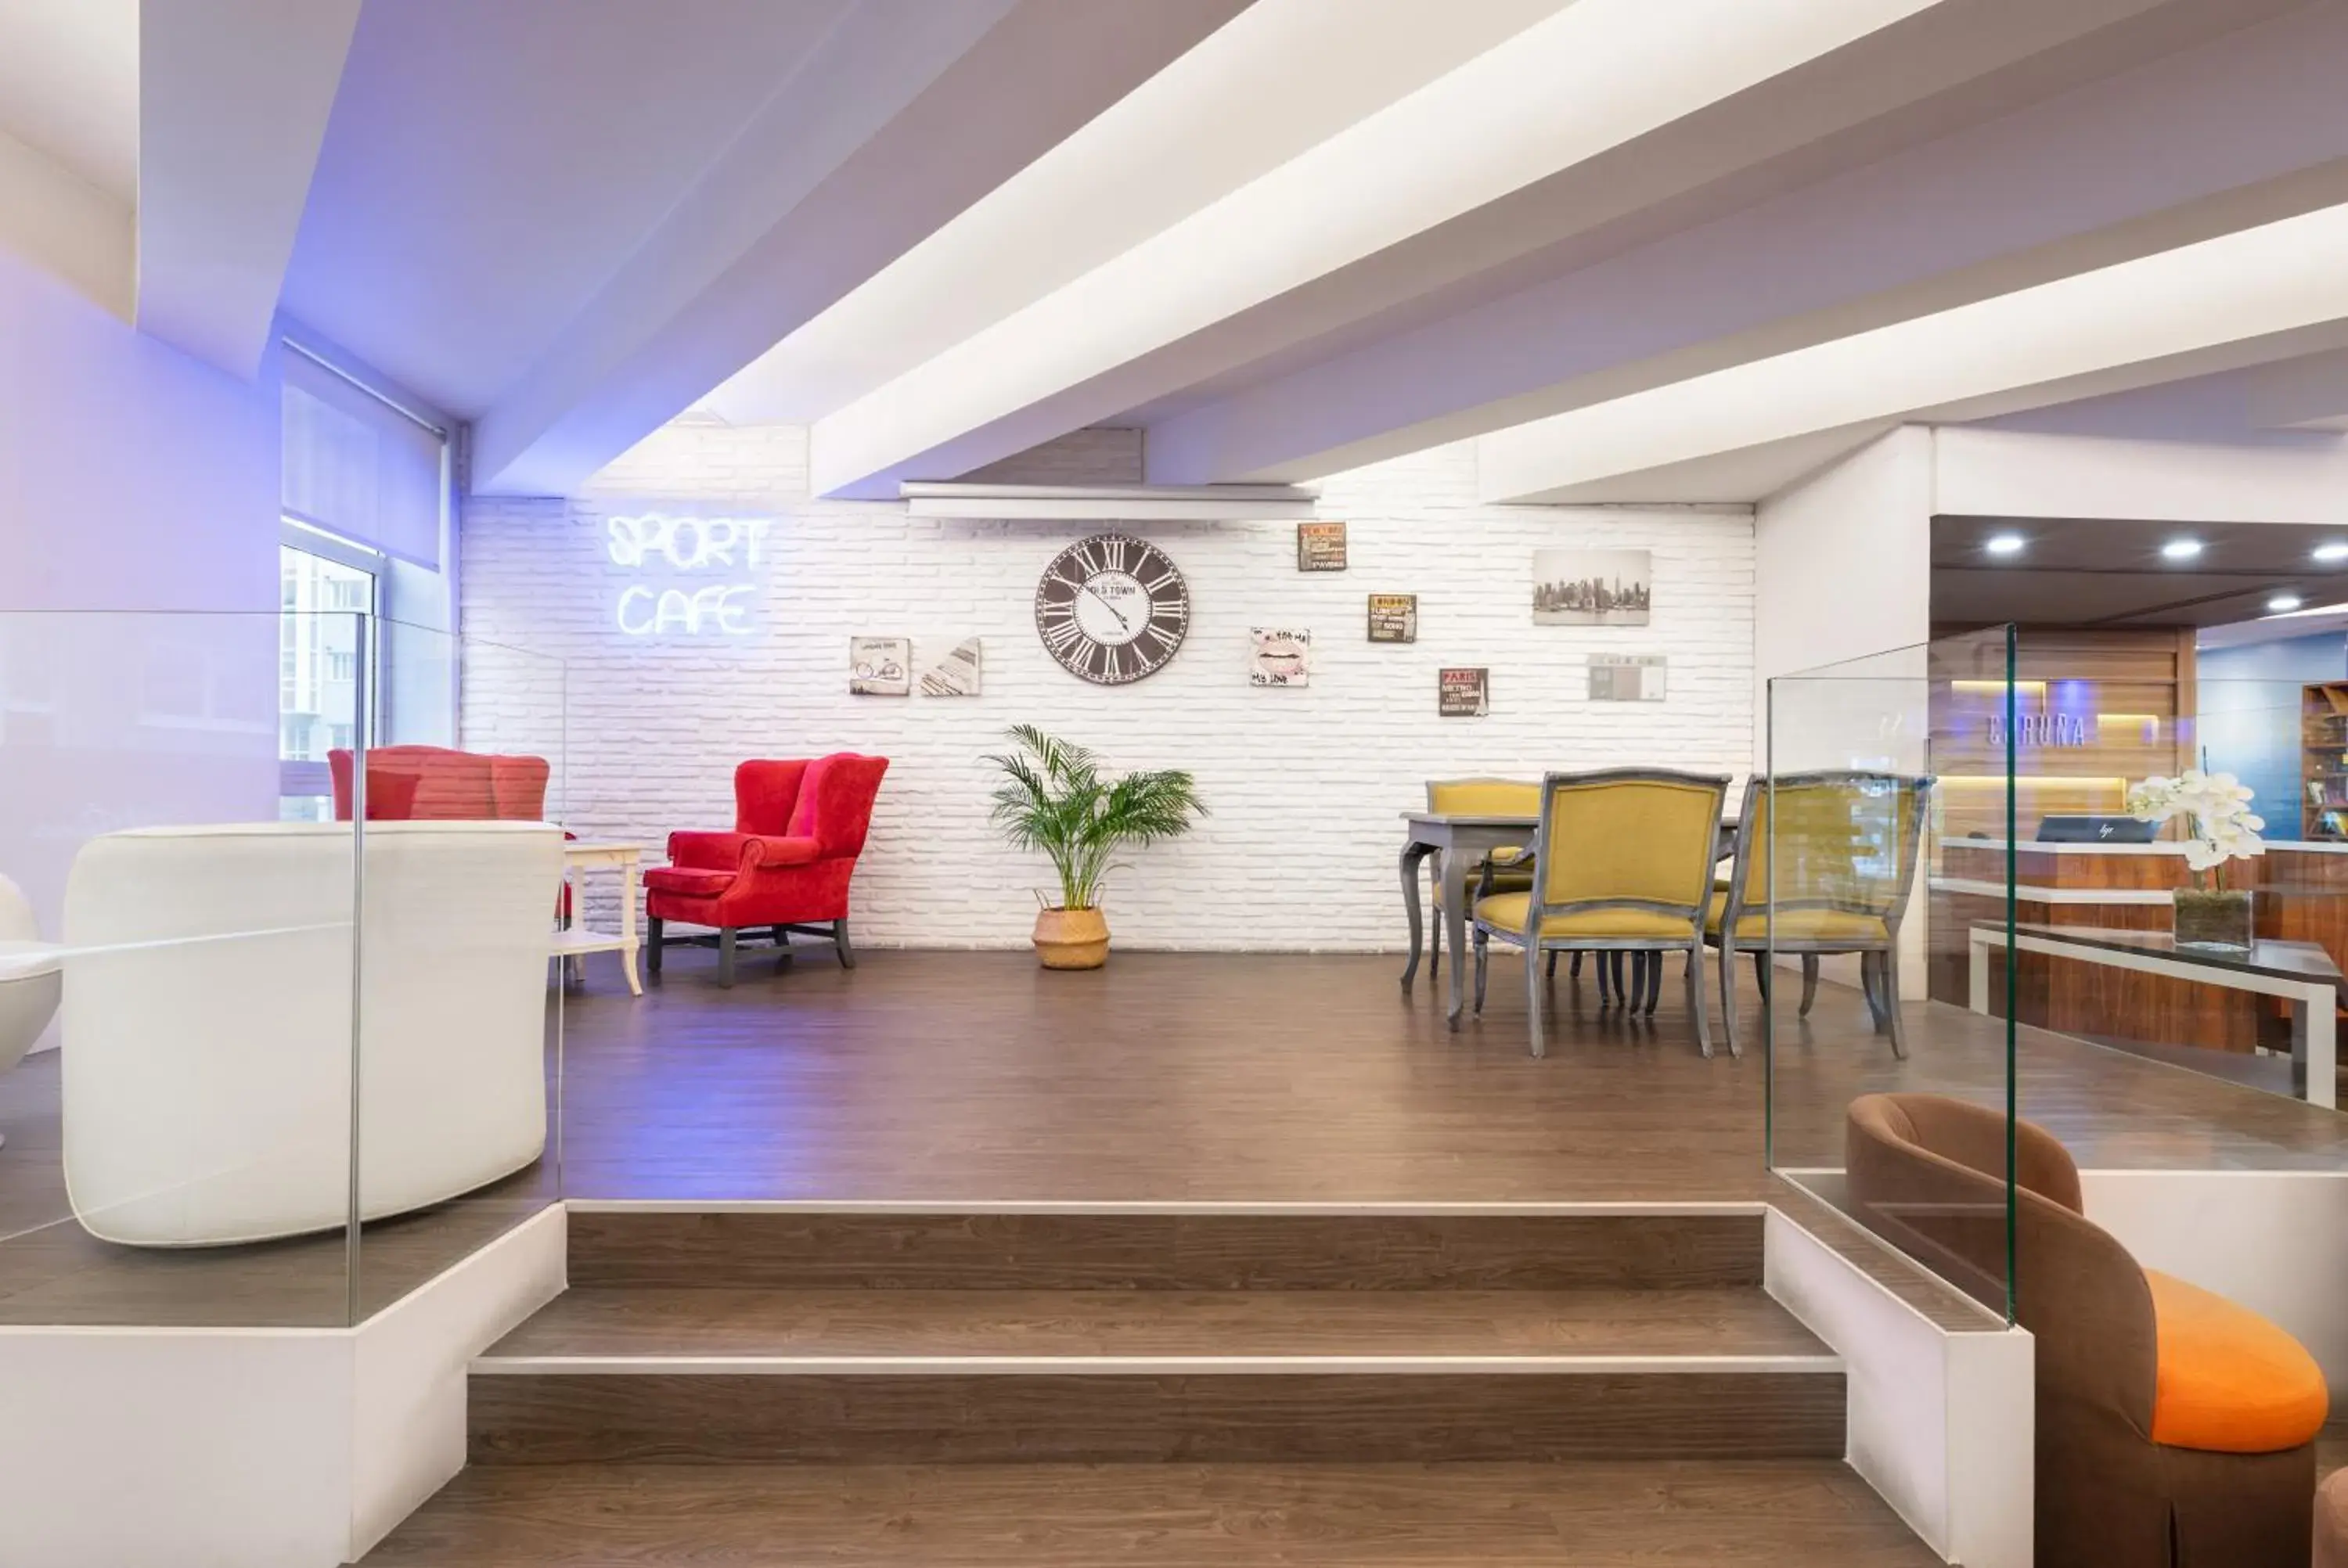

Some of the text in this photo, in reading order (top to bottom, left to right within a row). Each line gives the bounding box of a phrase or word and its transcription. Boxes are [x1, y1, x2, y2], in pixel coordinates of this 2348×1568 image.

[608, 513, 769, 570] SPORT
[1110, 586, 1135, 595] TOWN
[618, 584, 757, 635] CAFE
[1444, 672, 1476, 682] PARIS
[1990, 713, 2084, 747] CRUÑA
